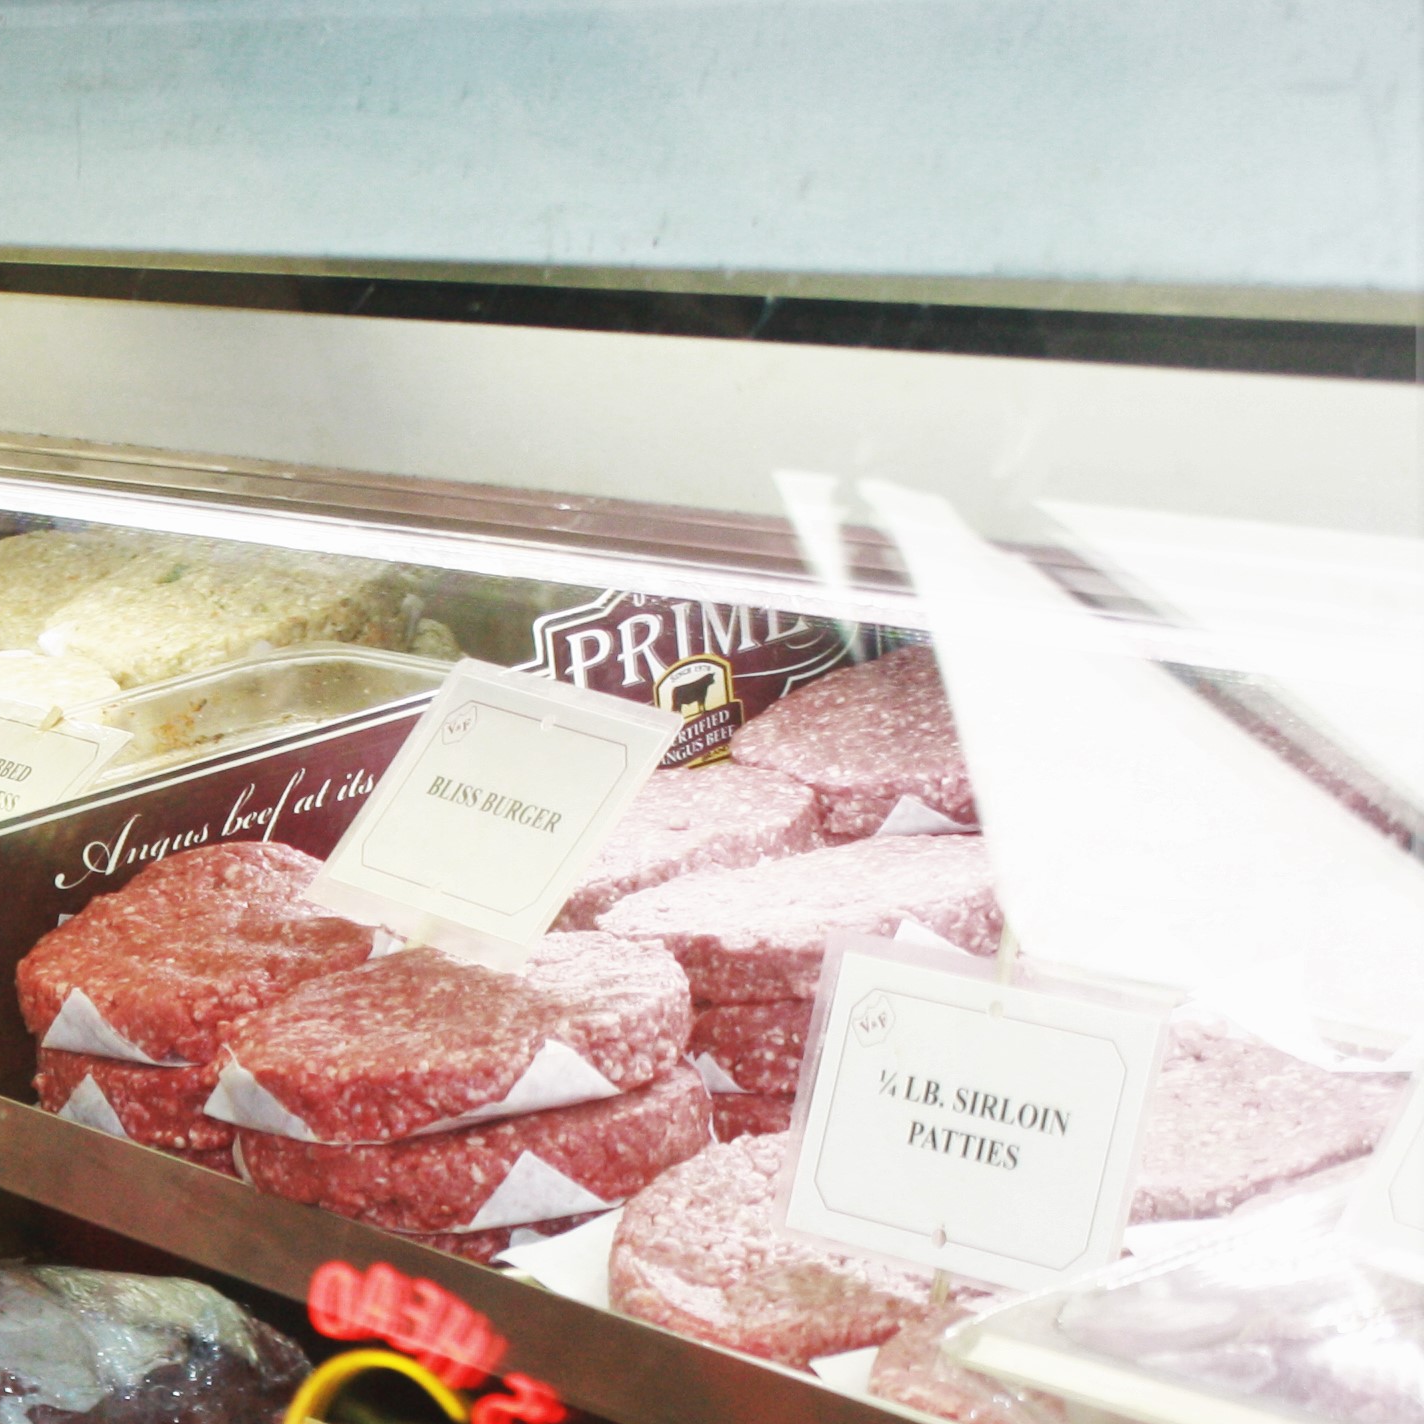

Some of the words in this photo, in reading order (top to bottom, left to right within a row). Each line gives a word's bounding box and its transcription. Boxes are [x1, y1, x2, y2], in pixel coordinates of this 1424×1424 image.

[54, 813, 209, 890] Angus
[220, 767, 306, 844] beef
[293, 778, 332, 815] at
[337, 768, 375, 803] its
[426, 775, 483, 809] BLISS
[479, 791, 563, 834] BURGER
[903, 1073, 946, 1111] LB.
[951, 1085, 1072, 1137] SIRLOIN
[906, 1120, 1023, 1172] PATTIES
